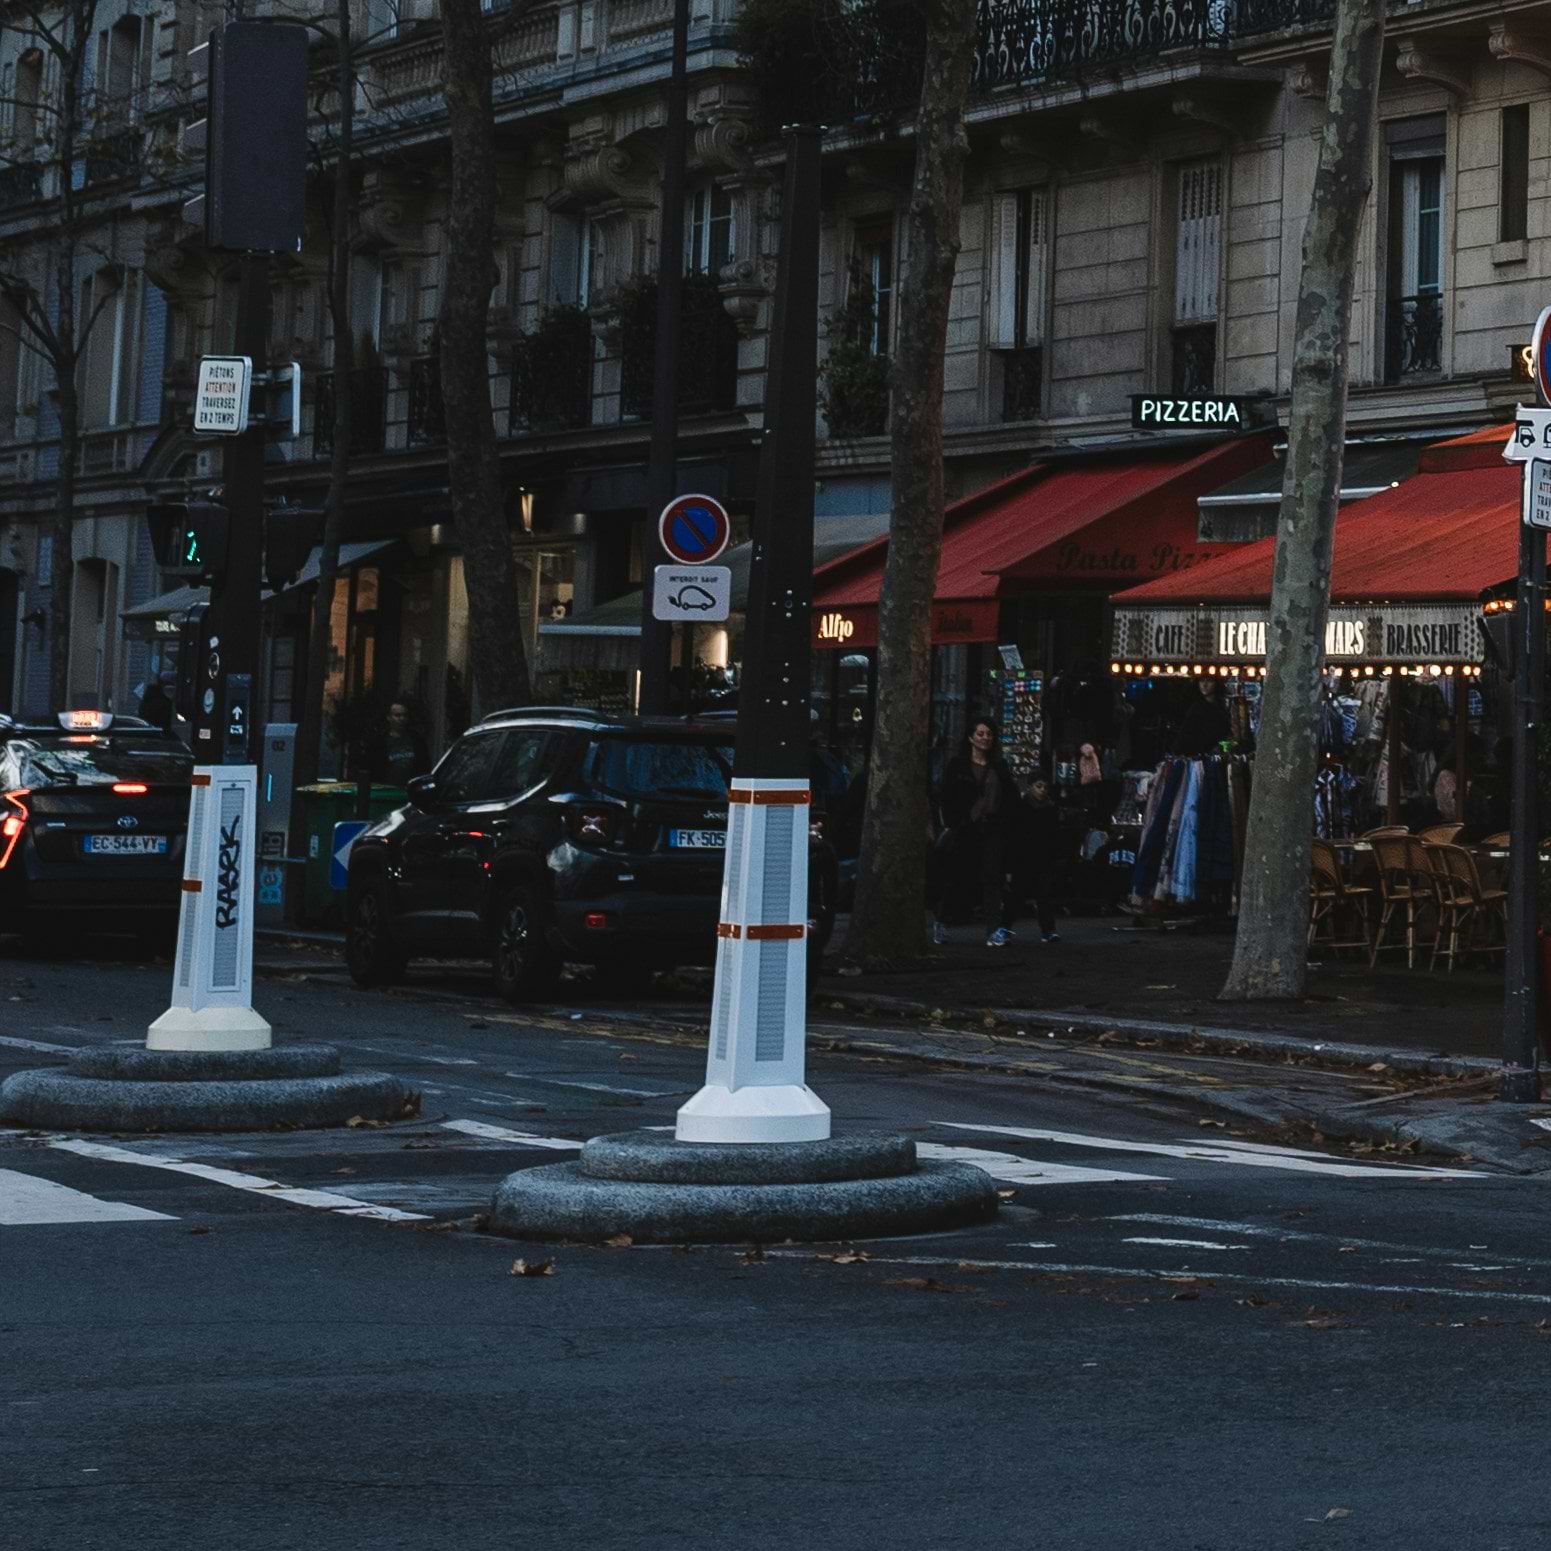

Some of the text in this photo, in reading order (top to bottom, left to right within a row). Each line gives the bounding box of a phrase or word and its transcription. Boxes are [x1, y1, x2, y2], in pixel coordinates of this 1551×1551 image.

[209, 365, 234, 378] PIÉTONS
[205, 381, 236, 393] ATTENTION
[202, 396, 236, 409] TRAVERSEZ
[200, 411, 208, 424] EN
[215, 411, 235, 424] TEMPS
[1141, 400, 1239, 423] PIZZERIA
[1536, 508, 1545, 519] EN
[1056, 543, 1137, 572] Pasta
[1386, 624, 1461, 656] BRASSERIE
